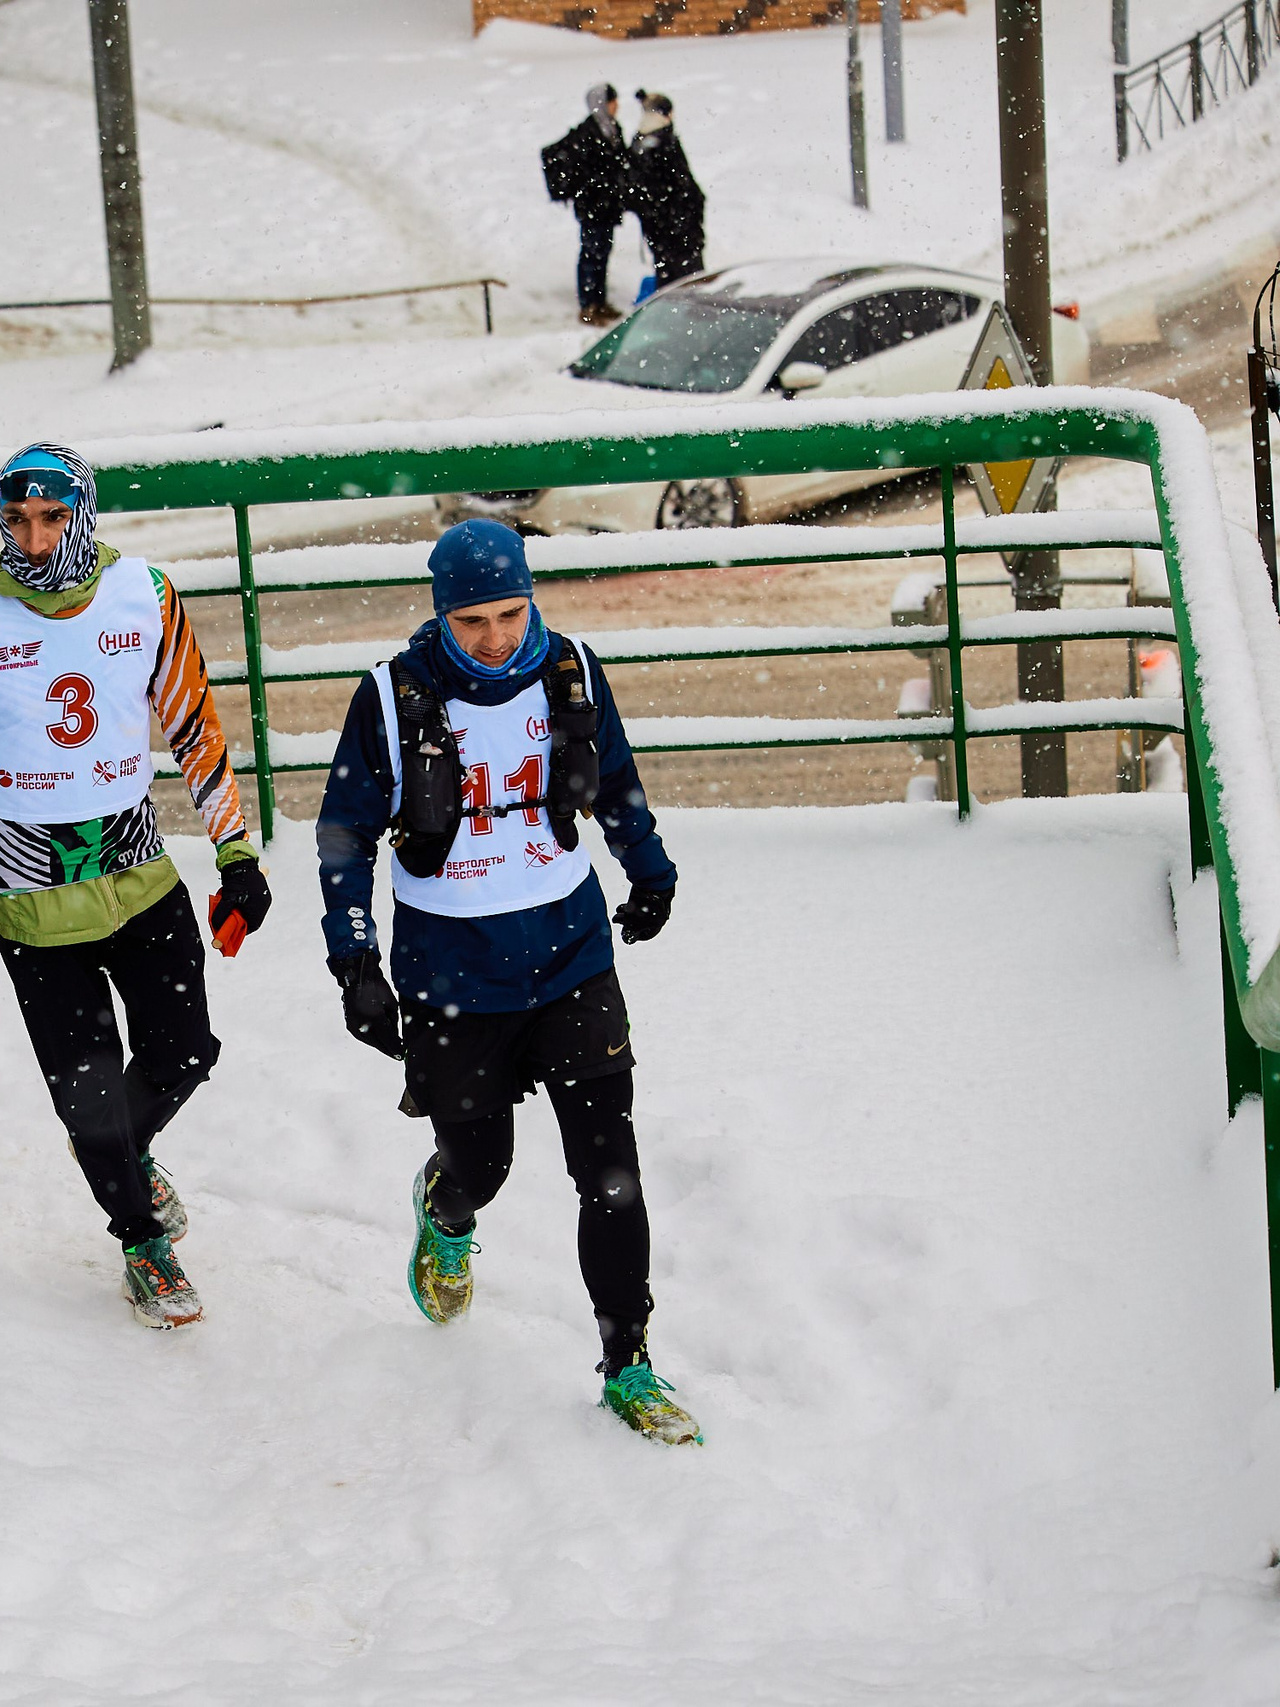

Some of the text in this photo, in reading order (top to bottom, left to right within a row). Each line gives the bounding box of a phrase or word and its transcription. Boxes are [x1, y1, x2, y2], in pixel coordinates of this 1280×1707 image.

[45, 672, 99, 749] 3
[16, 771, 75, 781] ВЕРТОЛЕТЫ
[16, 782, 56, 790] РОССИИ
[461, 754, 543, 836] 11
[446, 855, 506, 871] ВЕРТОЛЕТЫ
[446, 869, 488, 880] РОССИИ
